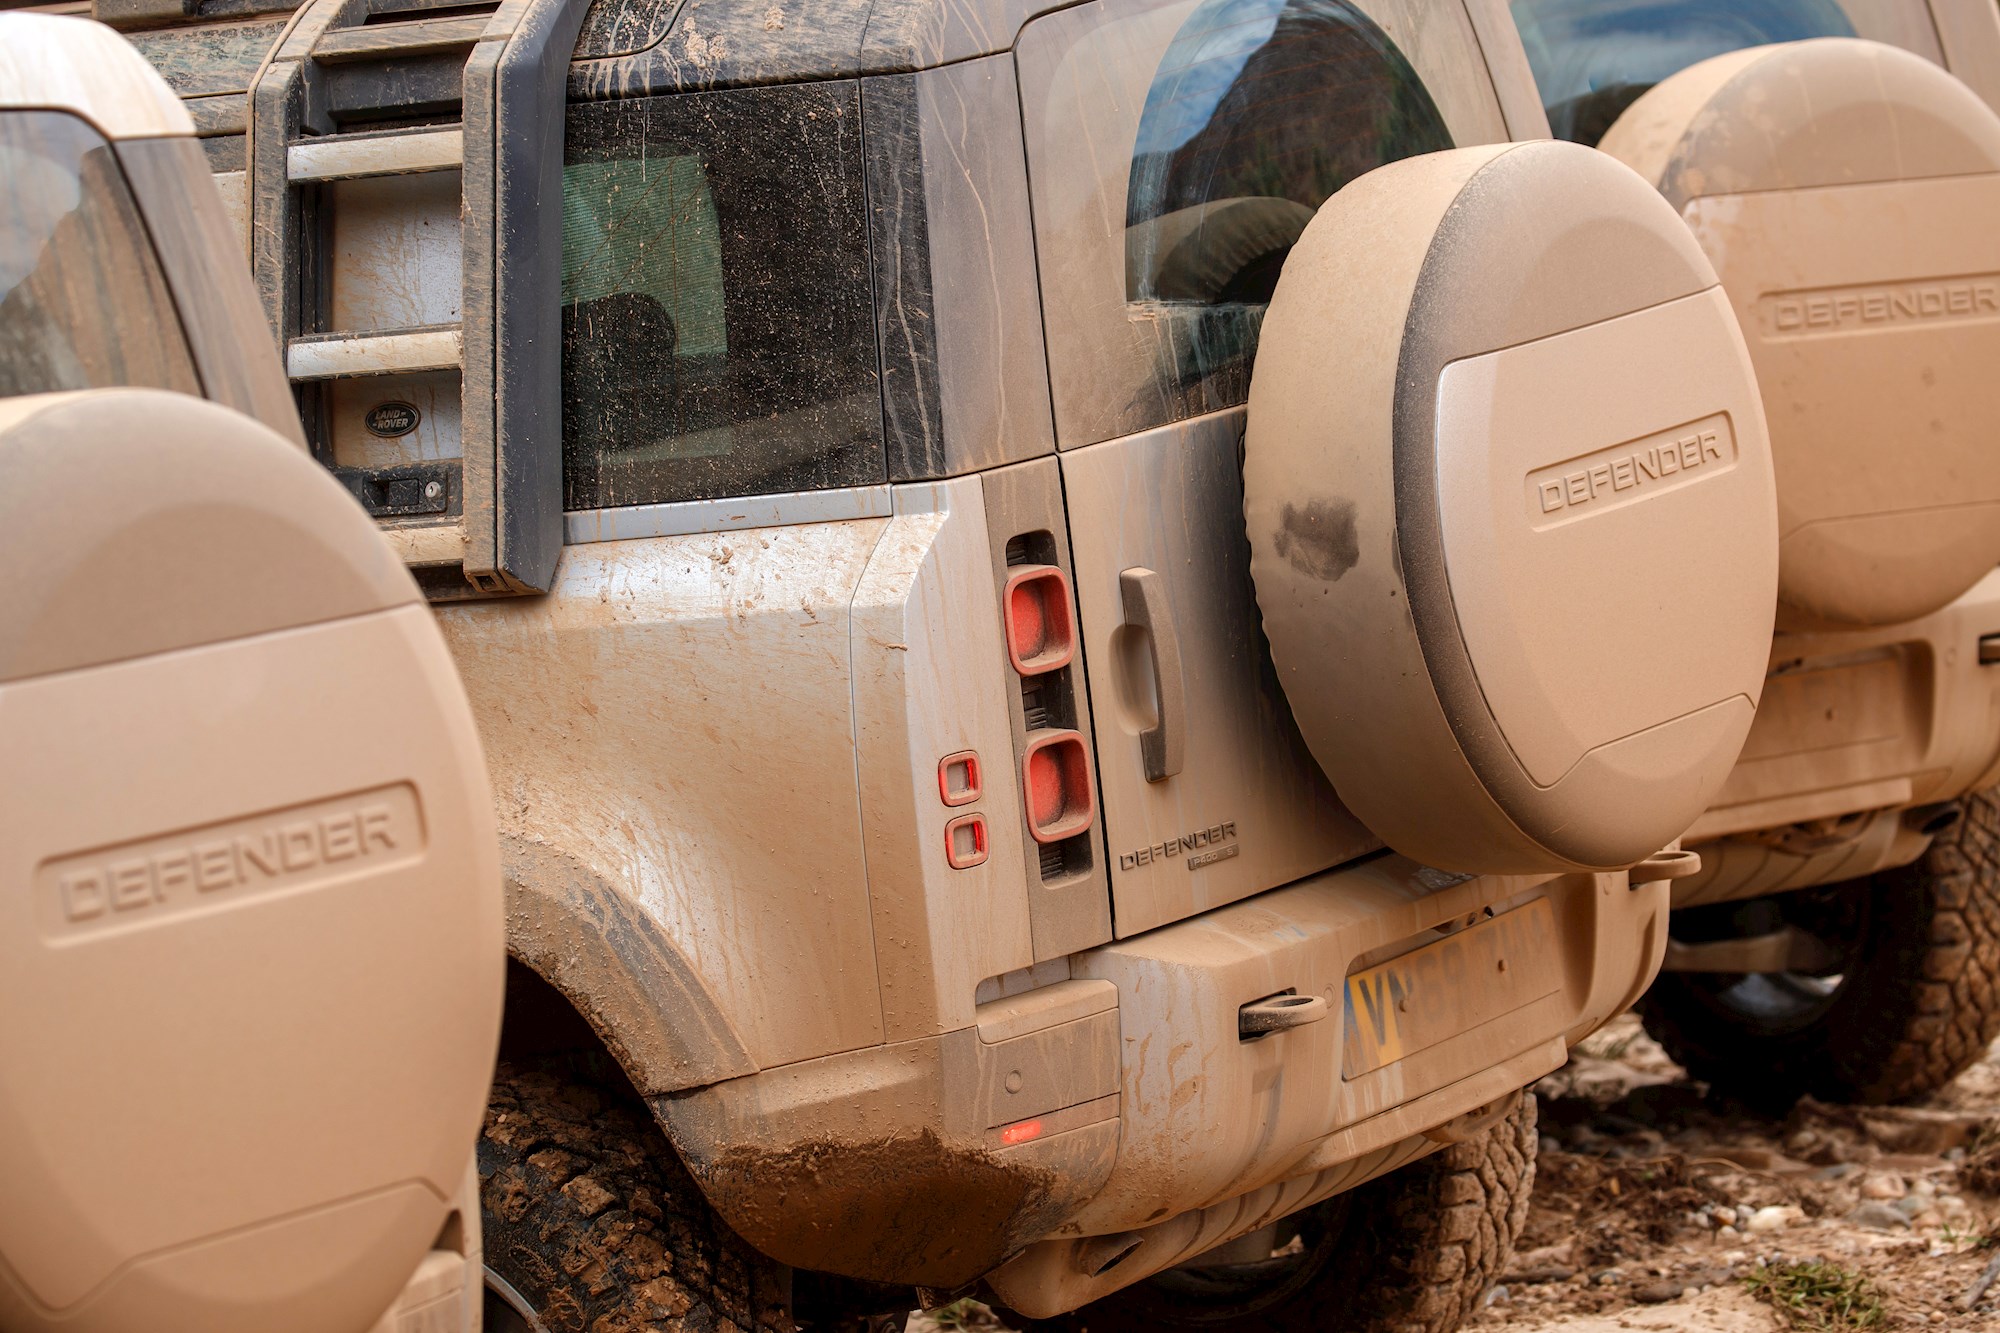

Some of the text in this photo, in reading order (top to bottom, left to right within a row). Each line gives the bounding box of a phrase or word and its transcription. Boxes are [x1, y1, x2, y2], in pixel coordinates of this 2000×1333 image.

[1775, 284, 1999, 332] DEFENDER
[1539, 429, 1721, 513] DEFENDER
[60, 803, 397, 924] DEFENDER
[1120, 820, 1237, 871] DEFENDER
